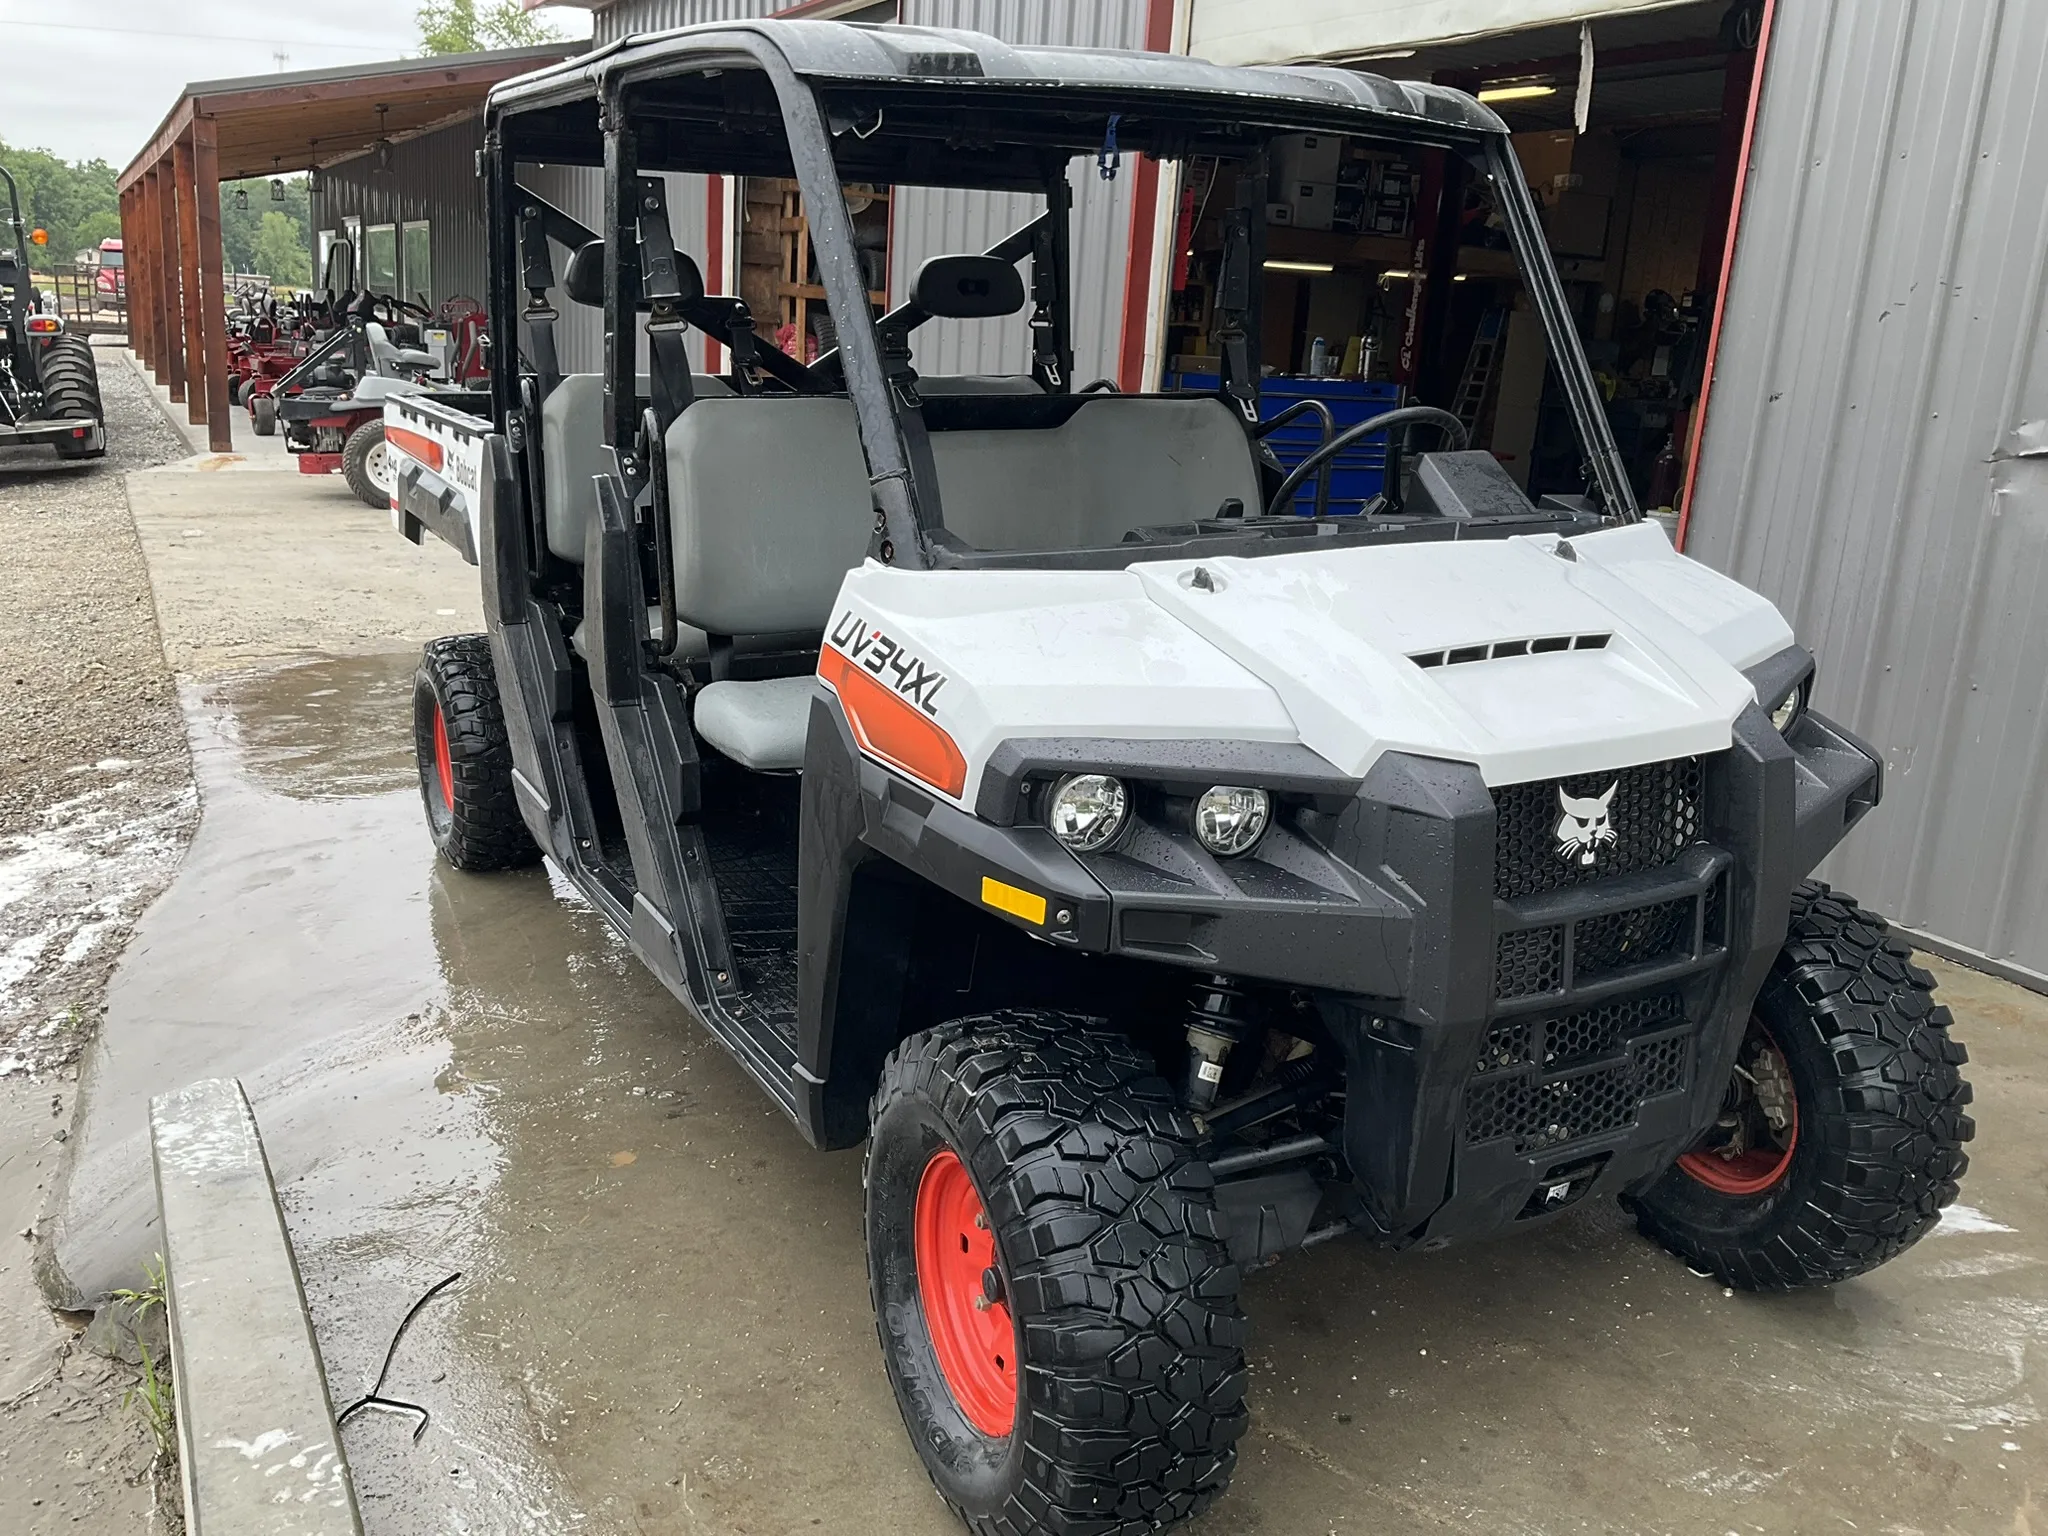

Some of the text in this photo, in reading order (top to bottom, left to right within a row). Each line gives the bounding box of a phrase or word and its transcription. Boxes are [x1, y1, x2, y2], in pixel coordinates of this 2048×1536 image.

[456, 455, 478, 492] Bobcat
[831, 610, 948, 717] UV34XL
[885, 1302, 952, 1453] DURO
